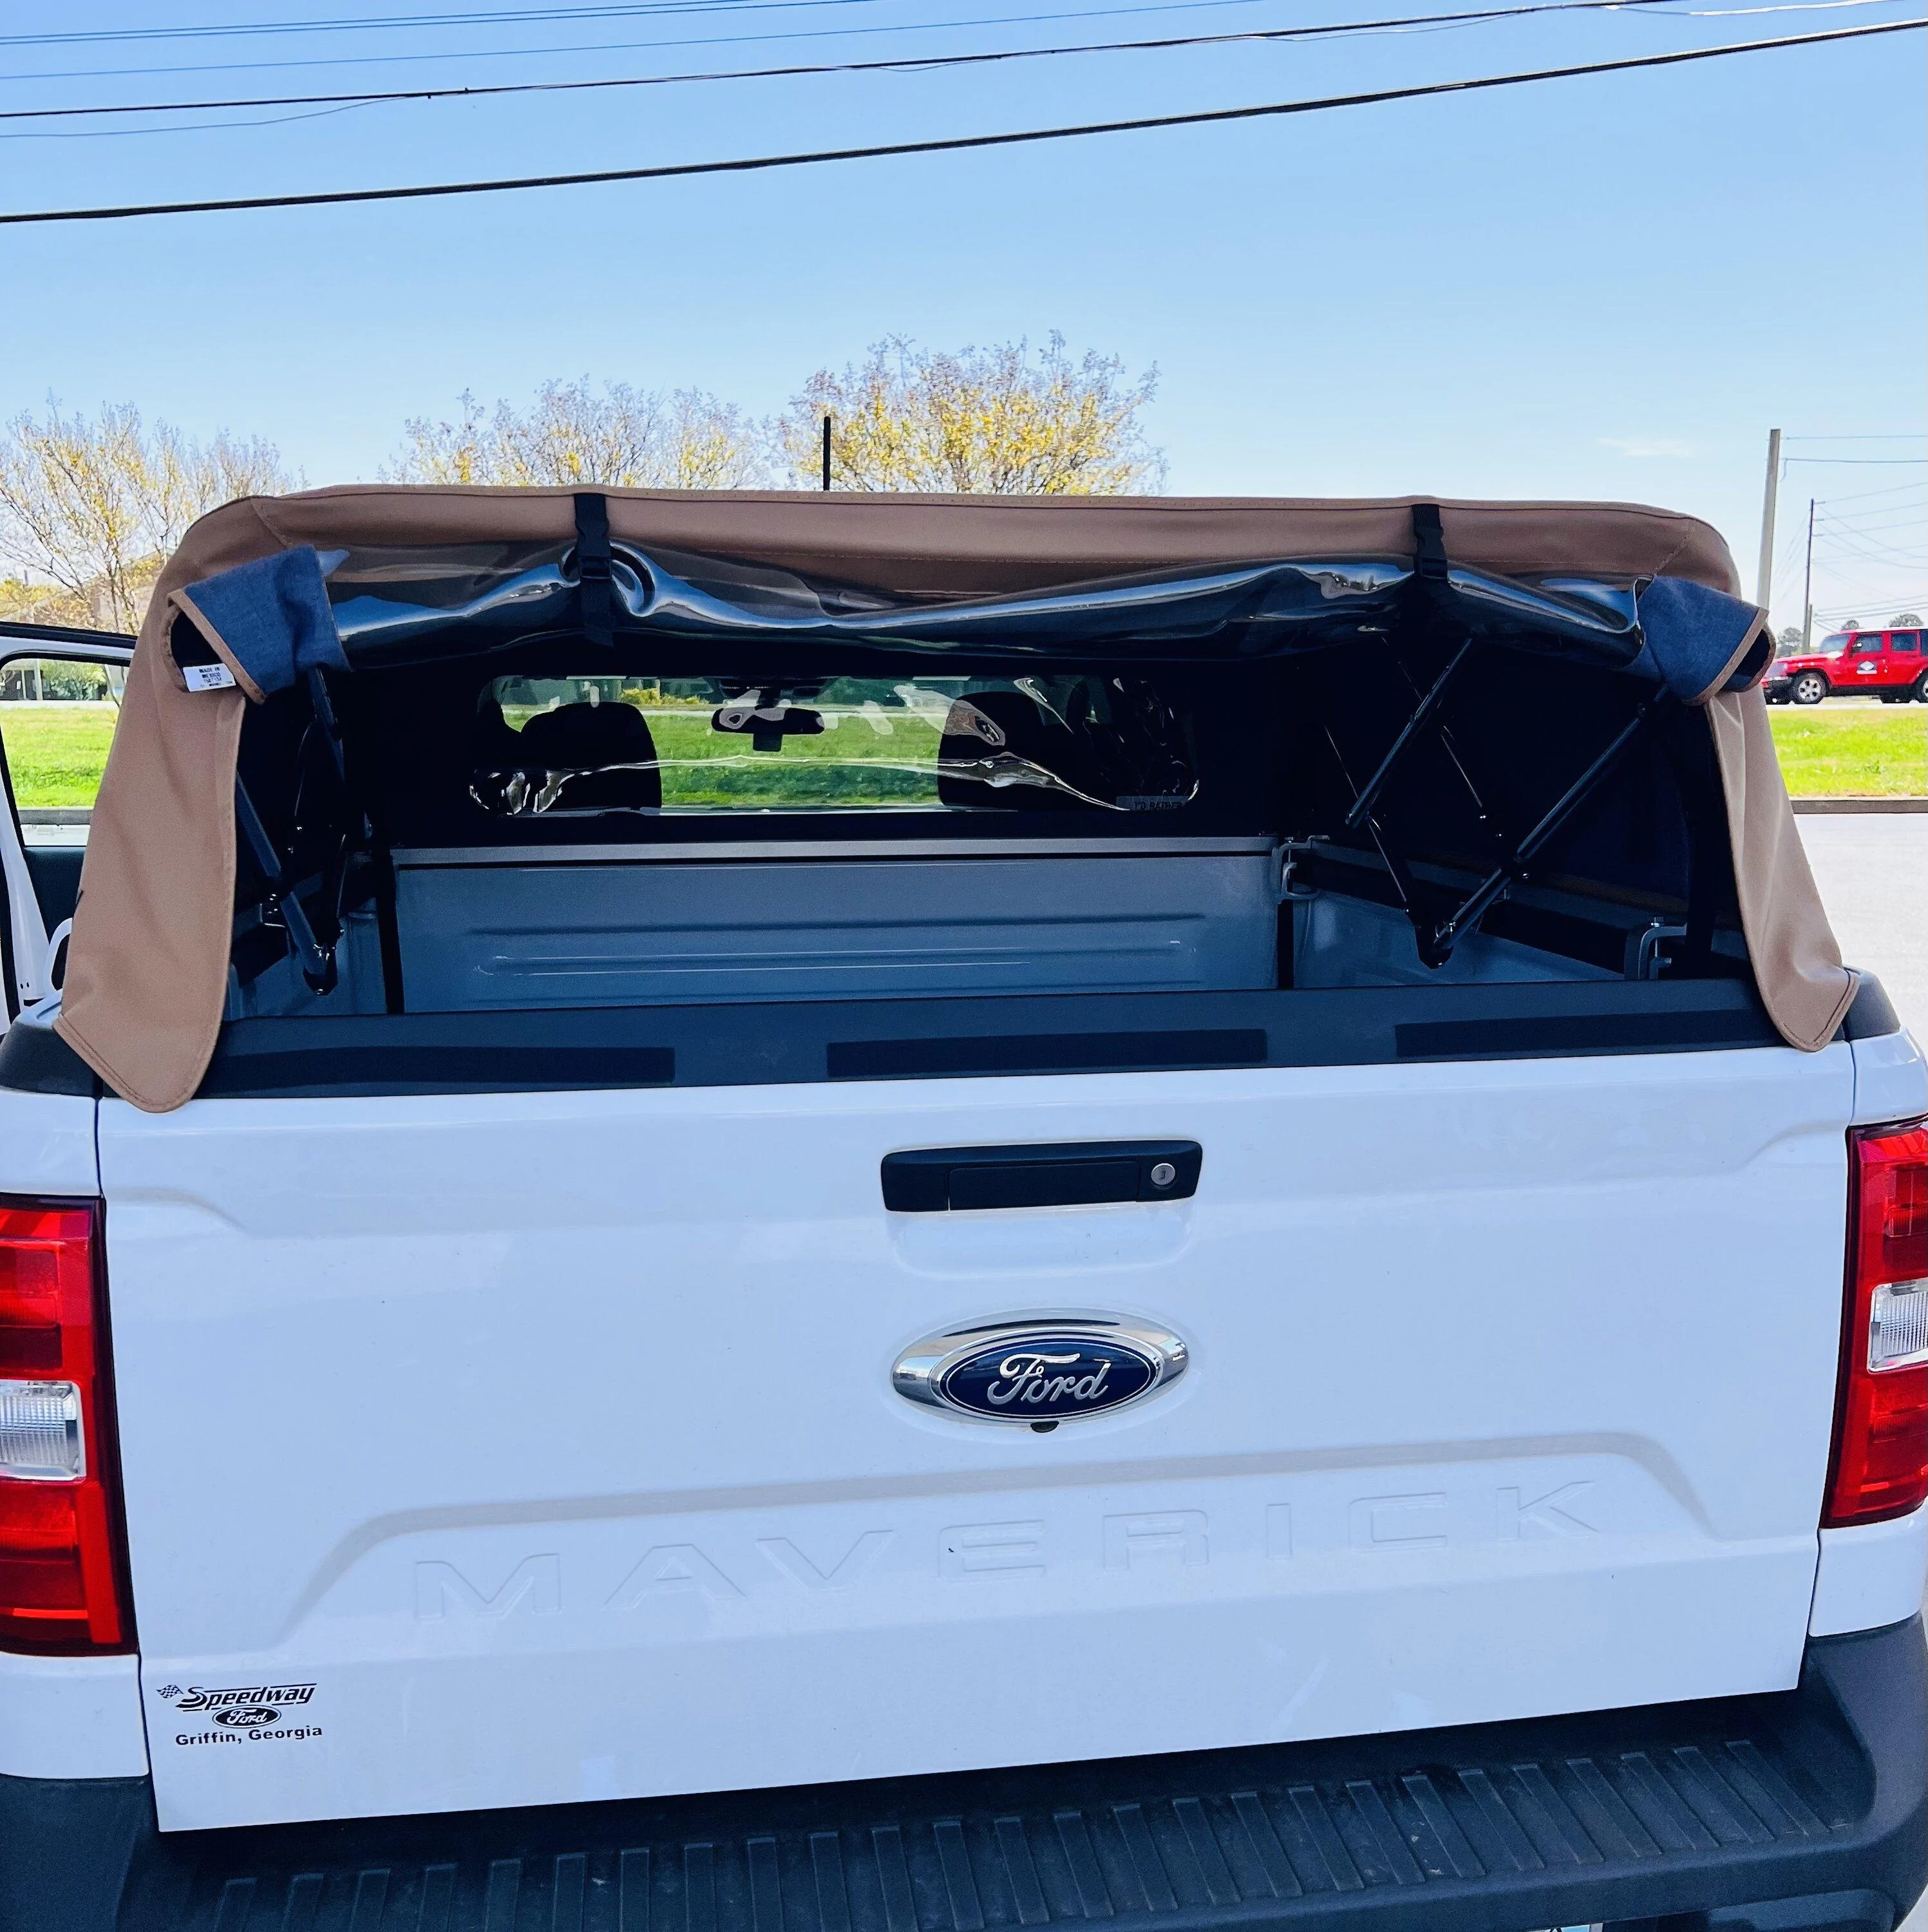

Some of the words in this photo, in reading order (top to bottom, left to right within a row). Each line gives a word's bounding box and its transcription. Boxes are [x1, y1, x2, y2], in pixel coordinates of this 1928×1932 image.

[987, 1352, 1112, 1405] Ford
[415, 1480, 1600, 1622] MAVERICK
[175, 1685, 316, 1711] Speedway
[226, 1709, 268, 1725] Ford
[175, 1732, 242, 1746] Griffin,
[249, 1725, 323, 1740] Georgia
